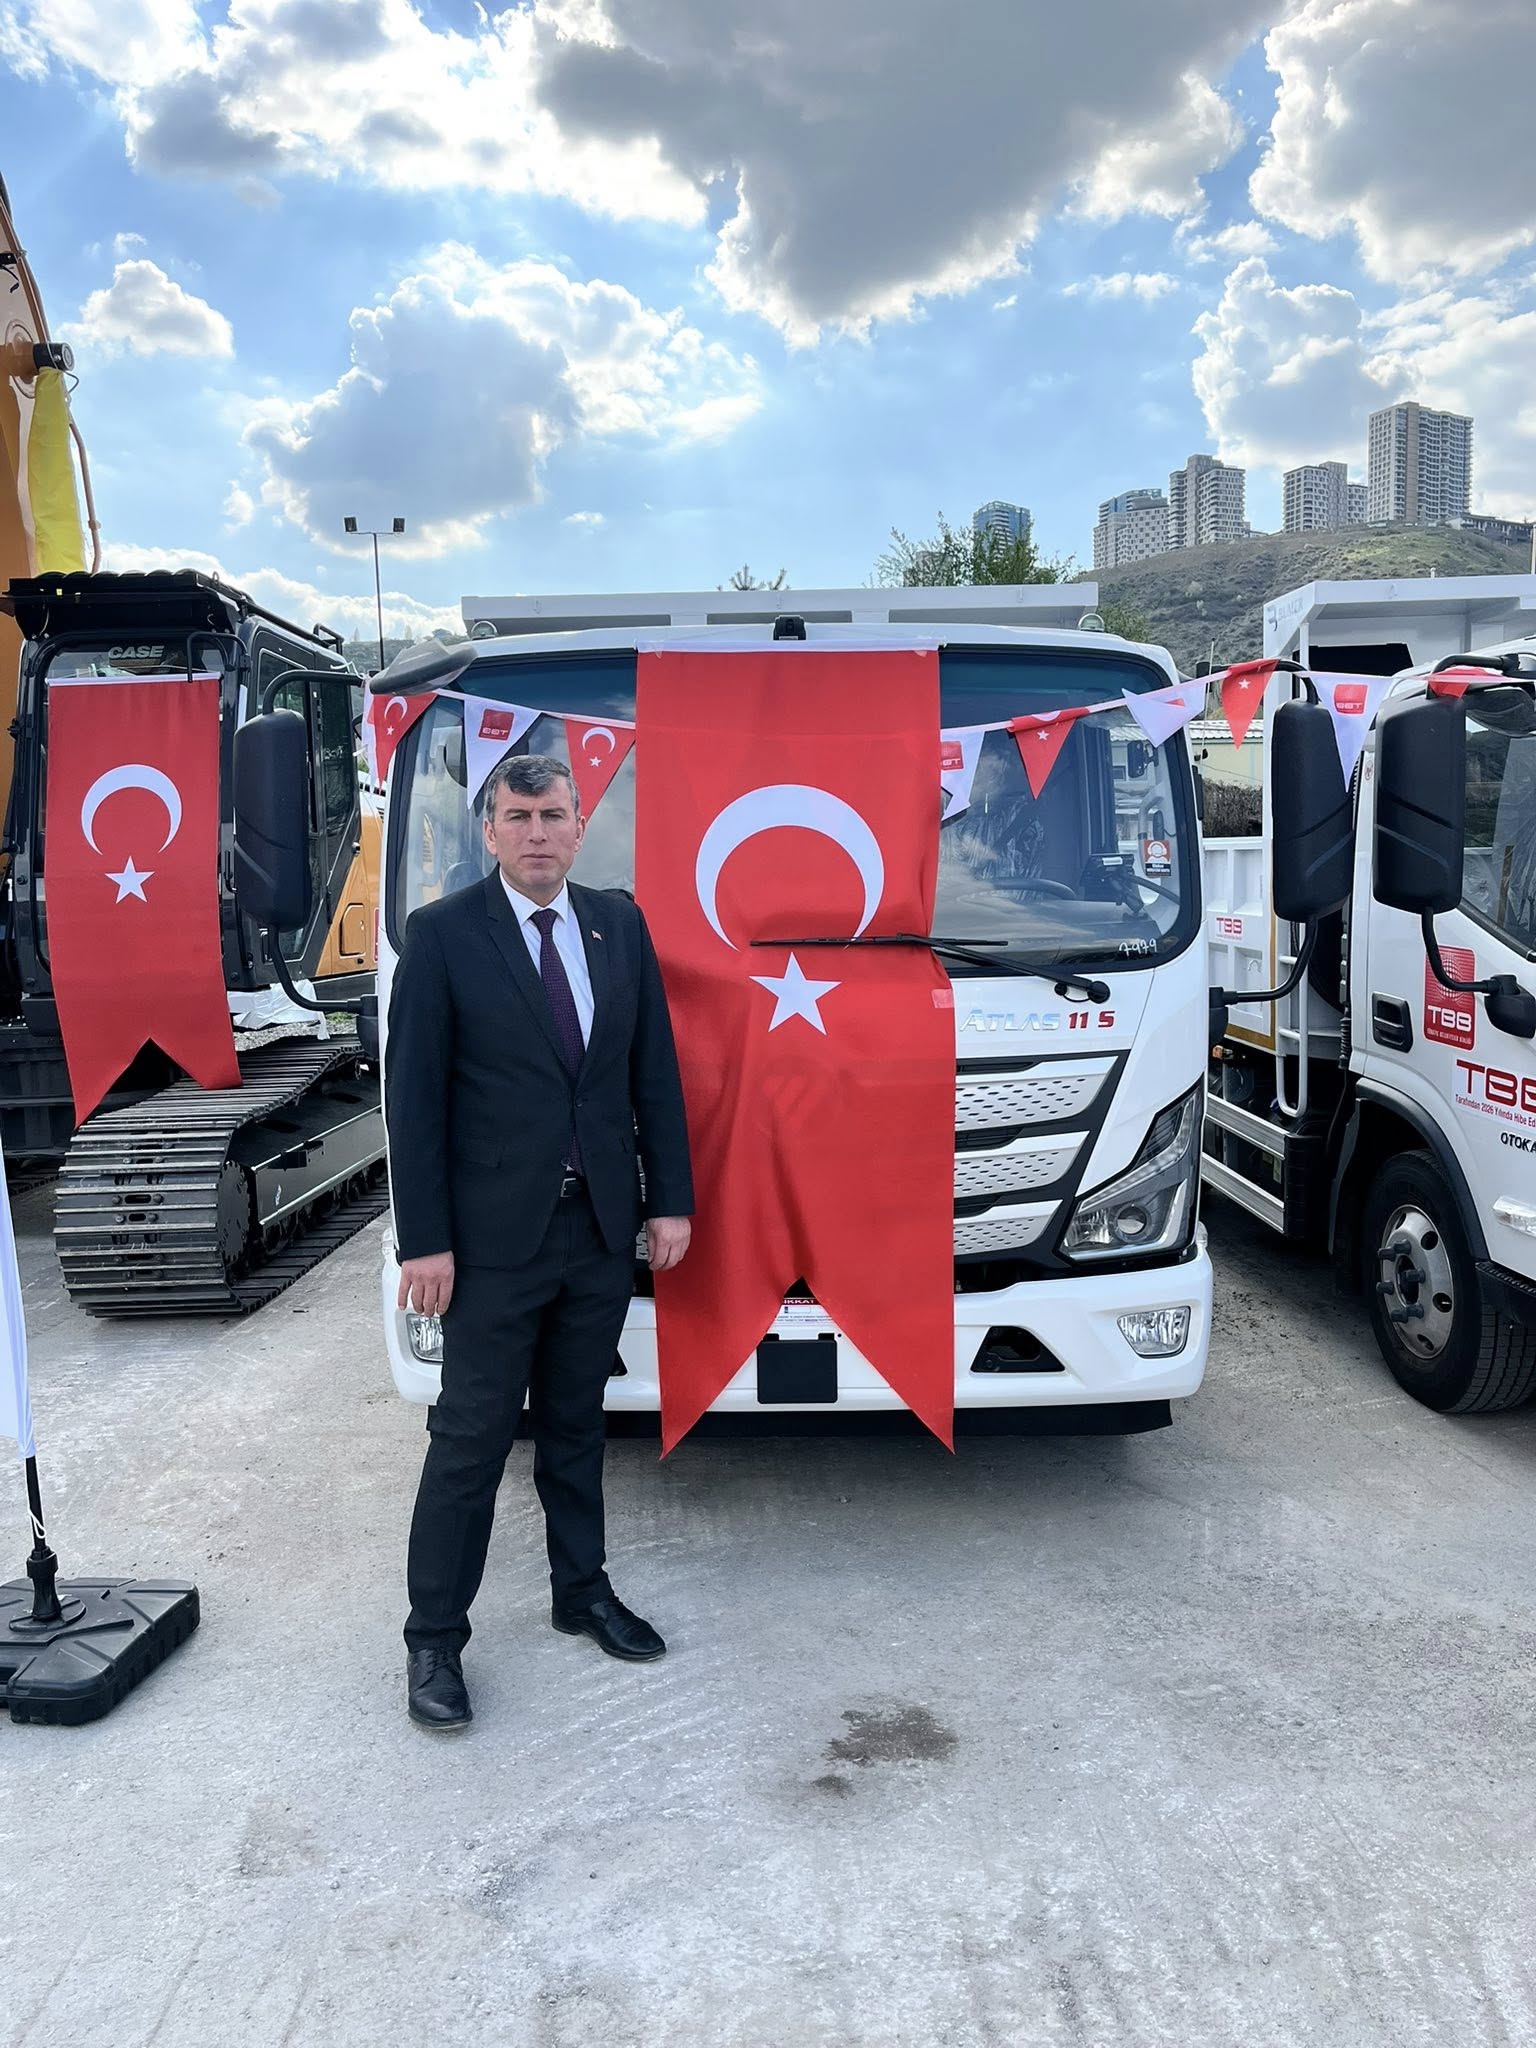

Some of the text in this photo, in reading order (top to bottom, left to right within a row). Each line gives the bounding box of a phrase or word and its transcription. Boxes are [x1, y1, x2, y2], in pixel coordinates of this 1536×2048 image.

[108, 645, 165, 659] CASE
[1216, 917, 1242, 934] TBB
[1119, 938, 1157, 957] 7979
[960, 1008, 1115, 1032] ATLAS 11 S
[1427, 1004, 1472, 1032] TBB
[1481, 1102, 1494, 1115] 2026
